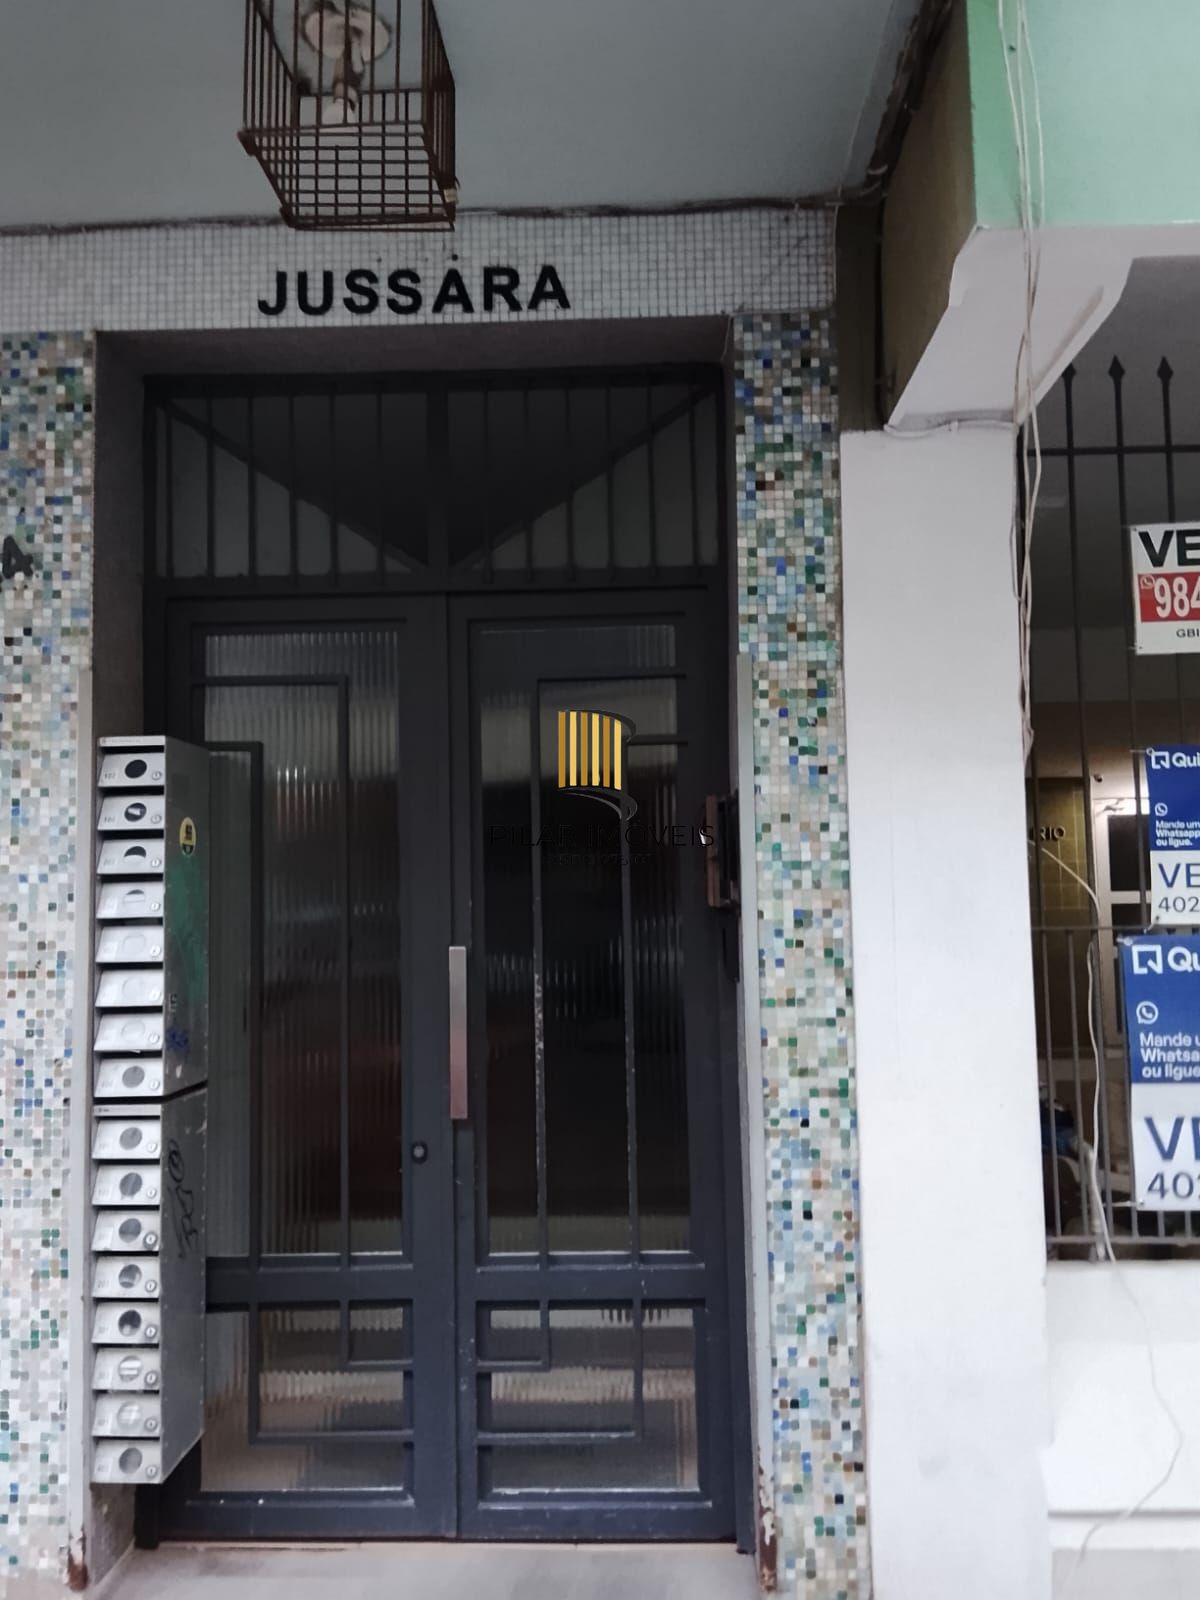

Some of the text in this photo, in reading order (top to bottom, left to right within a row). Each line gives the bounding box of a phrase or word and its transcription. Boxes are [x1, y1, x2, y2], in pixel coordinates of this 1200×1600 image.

[257, 264, 571, 316] JUSSARA
[1138, 528, 1200, 568] VE
[1158, 863, 1200, 888] VE
[1158, 896, 1200, 913] 402
[1139, 1032, 1192, 1047] Mande
[1142, 1066, 1162, 1078] ou
[1143, 1116, 1200, 1161] V
[1147, 1170, 1200, 1199] 40
